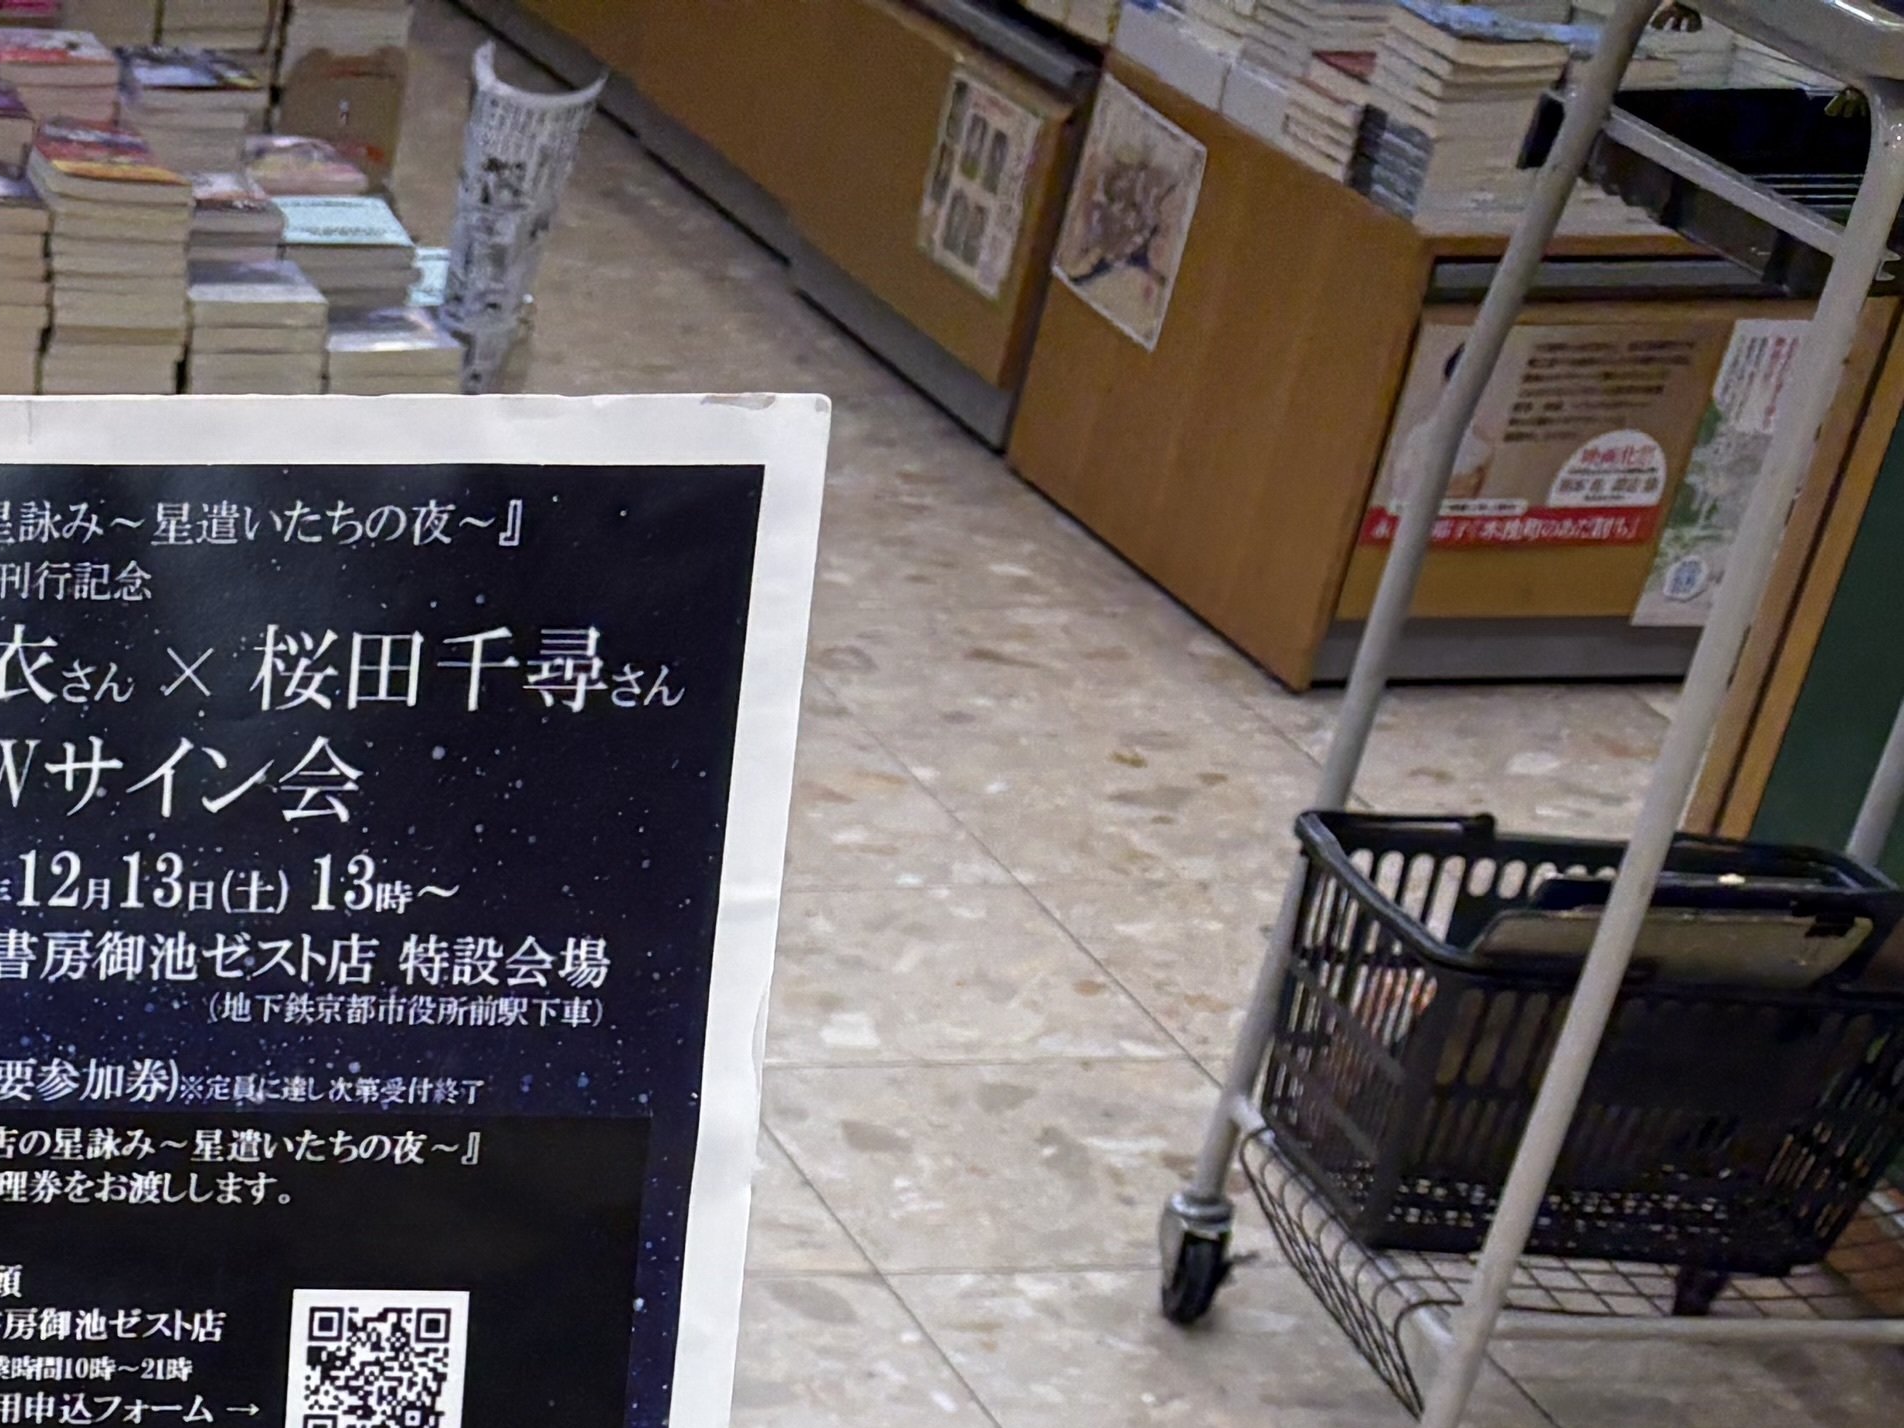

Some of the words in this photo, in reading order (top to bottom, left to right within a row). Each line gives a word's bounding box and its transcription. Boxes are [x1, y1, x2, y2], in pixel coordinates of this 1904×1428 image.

[251, 623, 685, 714] 桜田千尋さん
[309, 854, 462, 913] 13時～
[399, 934, 611, 988] 特設会場
